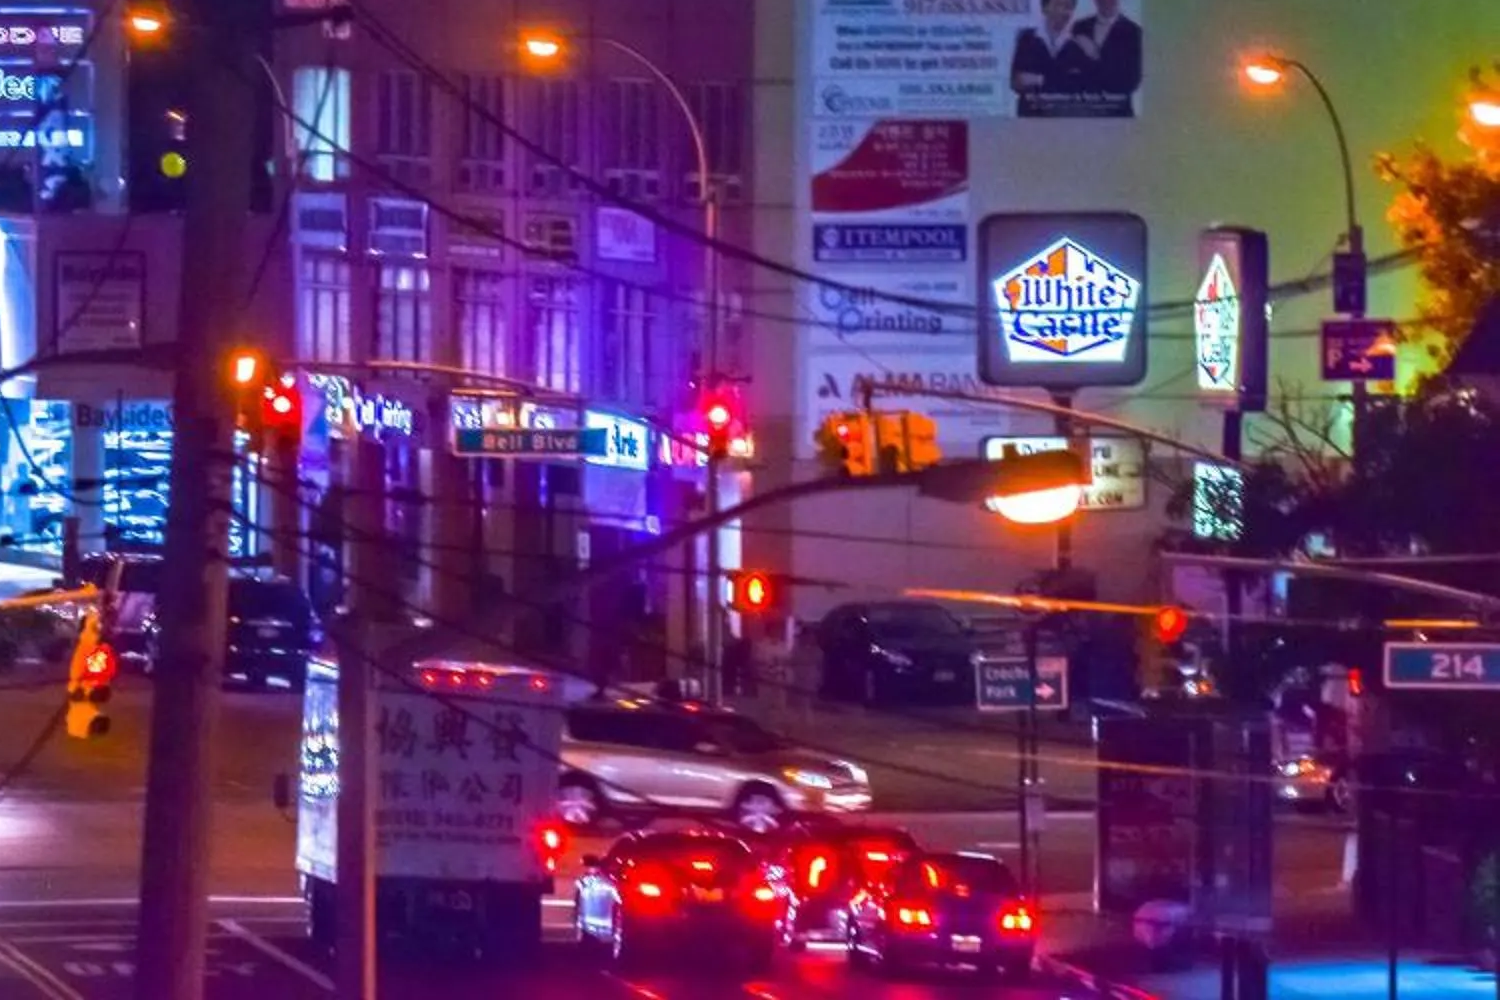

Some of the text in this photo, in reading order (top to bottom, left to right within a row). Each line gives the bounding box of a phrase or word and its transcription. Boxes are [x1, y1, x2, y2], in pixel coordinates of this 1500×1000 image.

[844, 229, 960, 247] ITEMPOOL
[1019, 276, 1117, 313] White
[1013, 312, 1122, 339] Castle
[482, 433, 577, 450] Bell Blvd
[1430, 653, 1485, 679] 214
